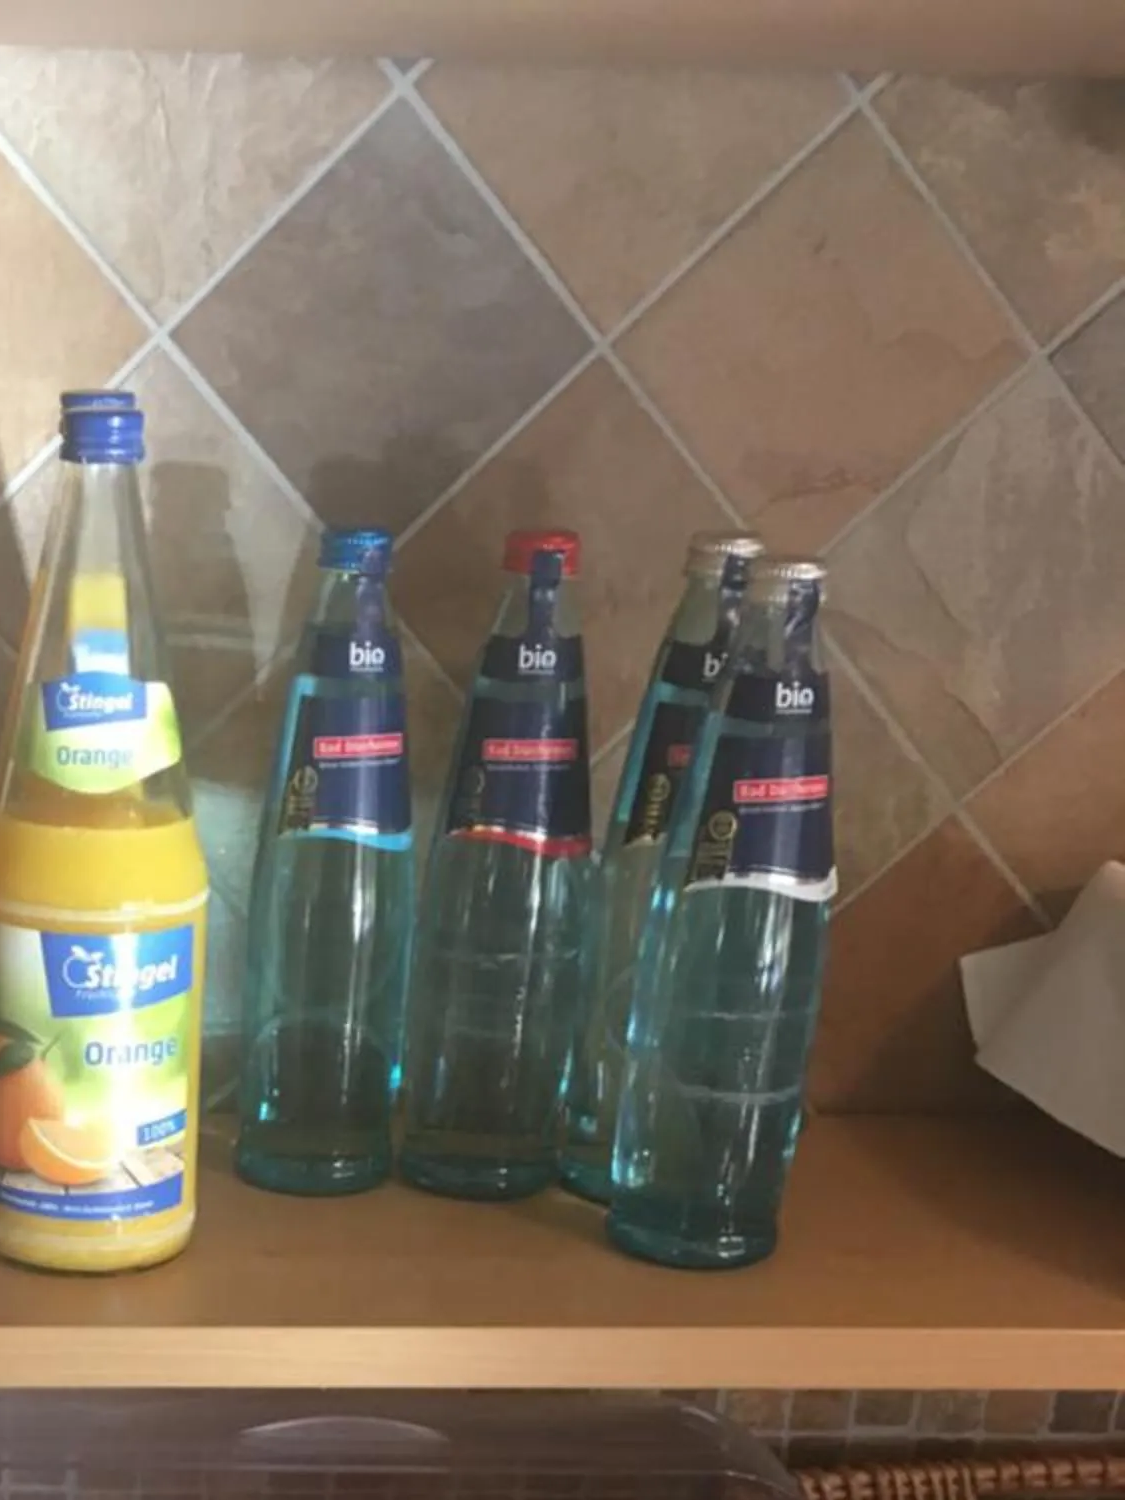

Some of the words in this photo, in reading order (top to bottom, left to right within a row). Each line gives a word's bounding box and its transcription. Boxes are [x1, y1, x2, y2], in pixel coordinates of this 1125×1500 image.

[349, 641, 385, 667] bio
[518, 645, 557, 670] bio
[776, 681, 815, 708] bio
[57, 746, 134, 770] Orange
[85, 954, 178, 991] Stgel
[84, 1037, 178, 1067] Orange
